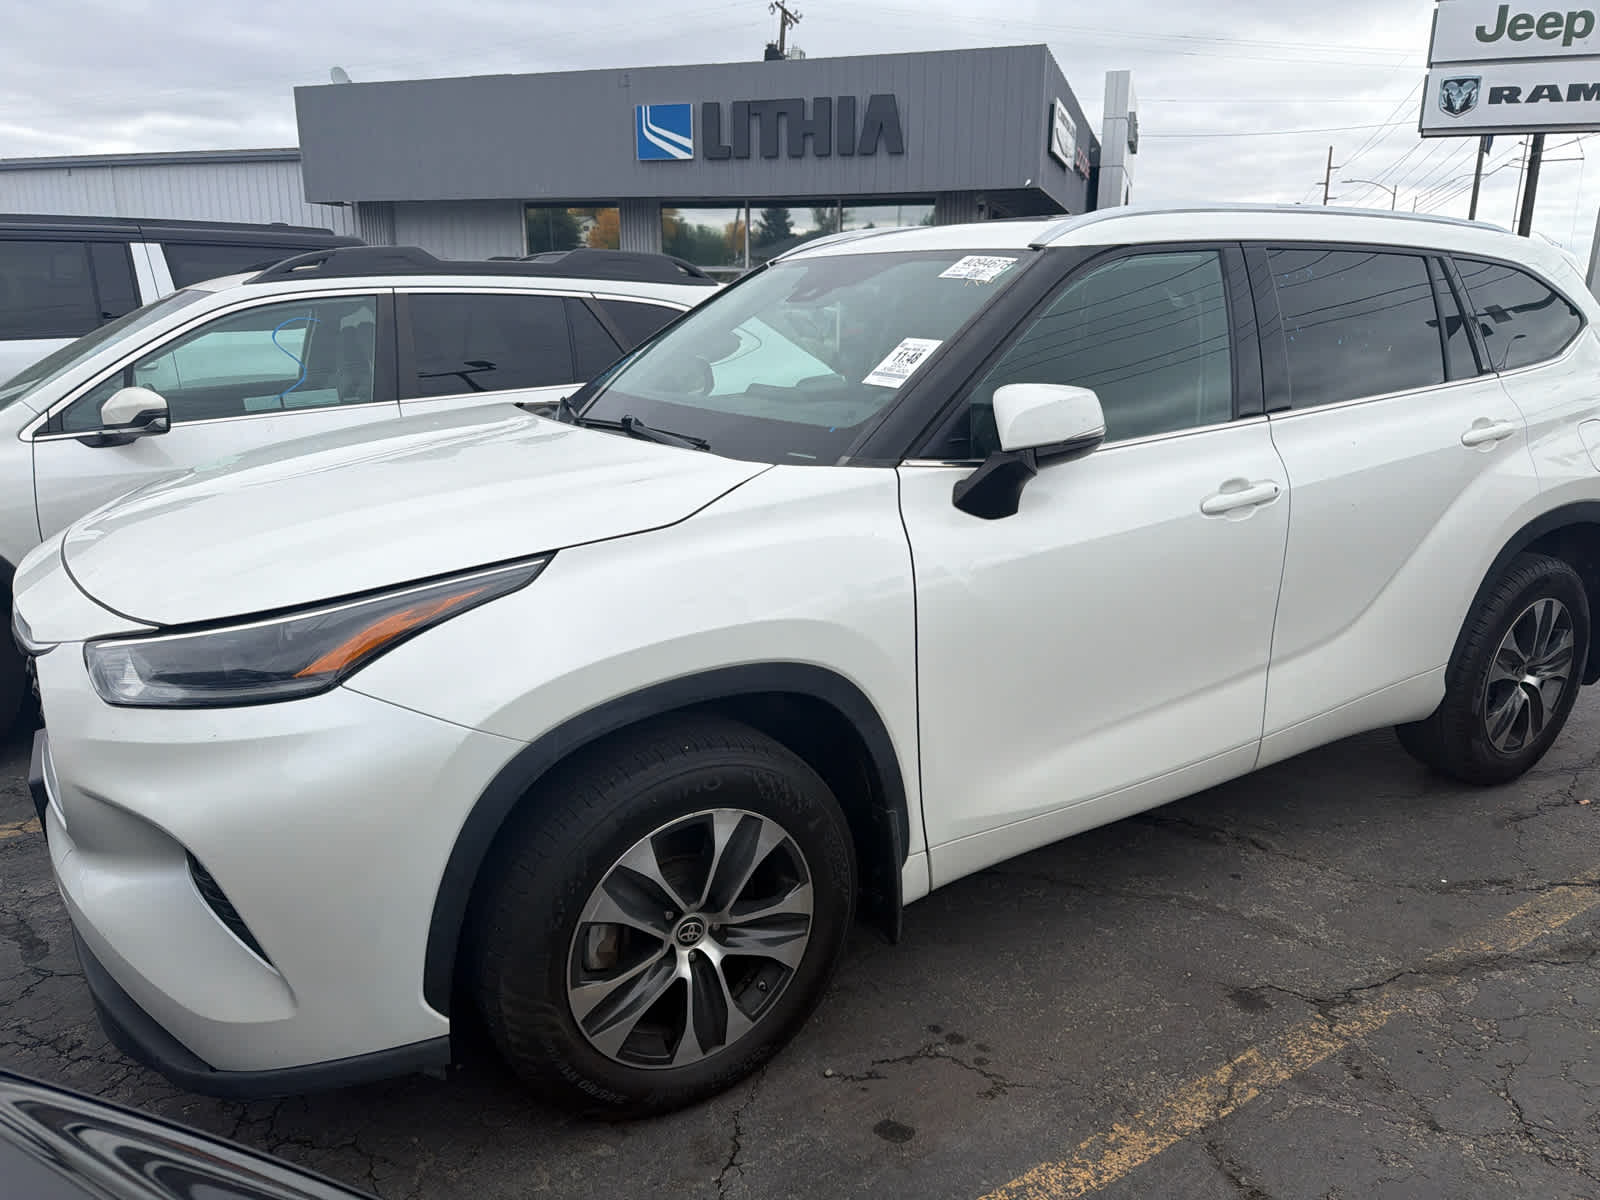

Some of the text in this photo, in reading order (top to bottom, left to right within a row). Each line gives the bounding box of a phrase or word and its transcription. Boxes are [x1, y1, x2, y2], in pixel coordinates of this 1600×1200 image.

[1475, 4, 1595, 47] Jeep
[1488, 82, 1600, 105] RAM
[702, 94, 904, 160] LITHIA
